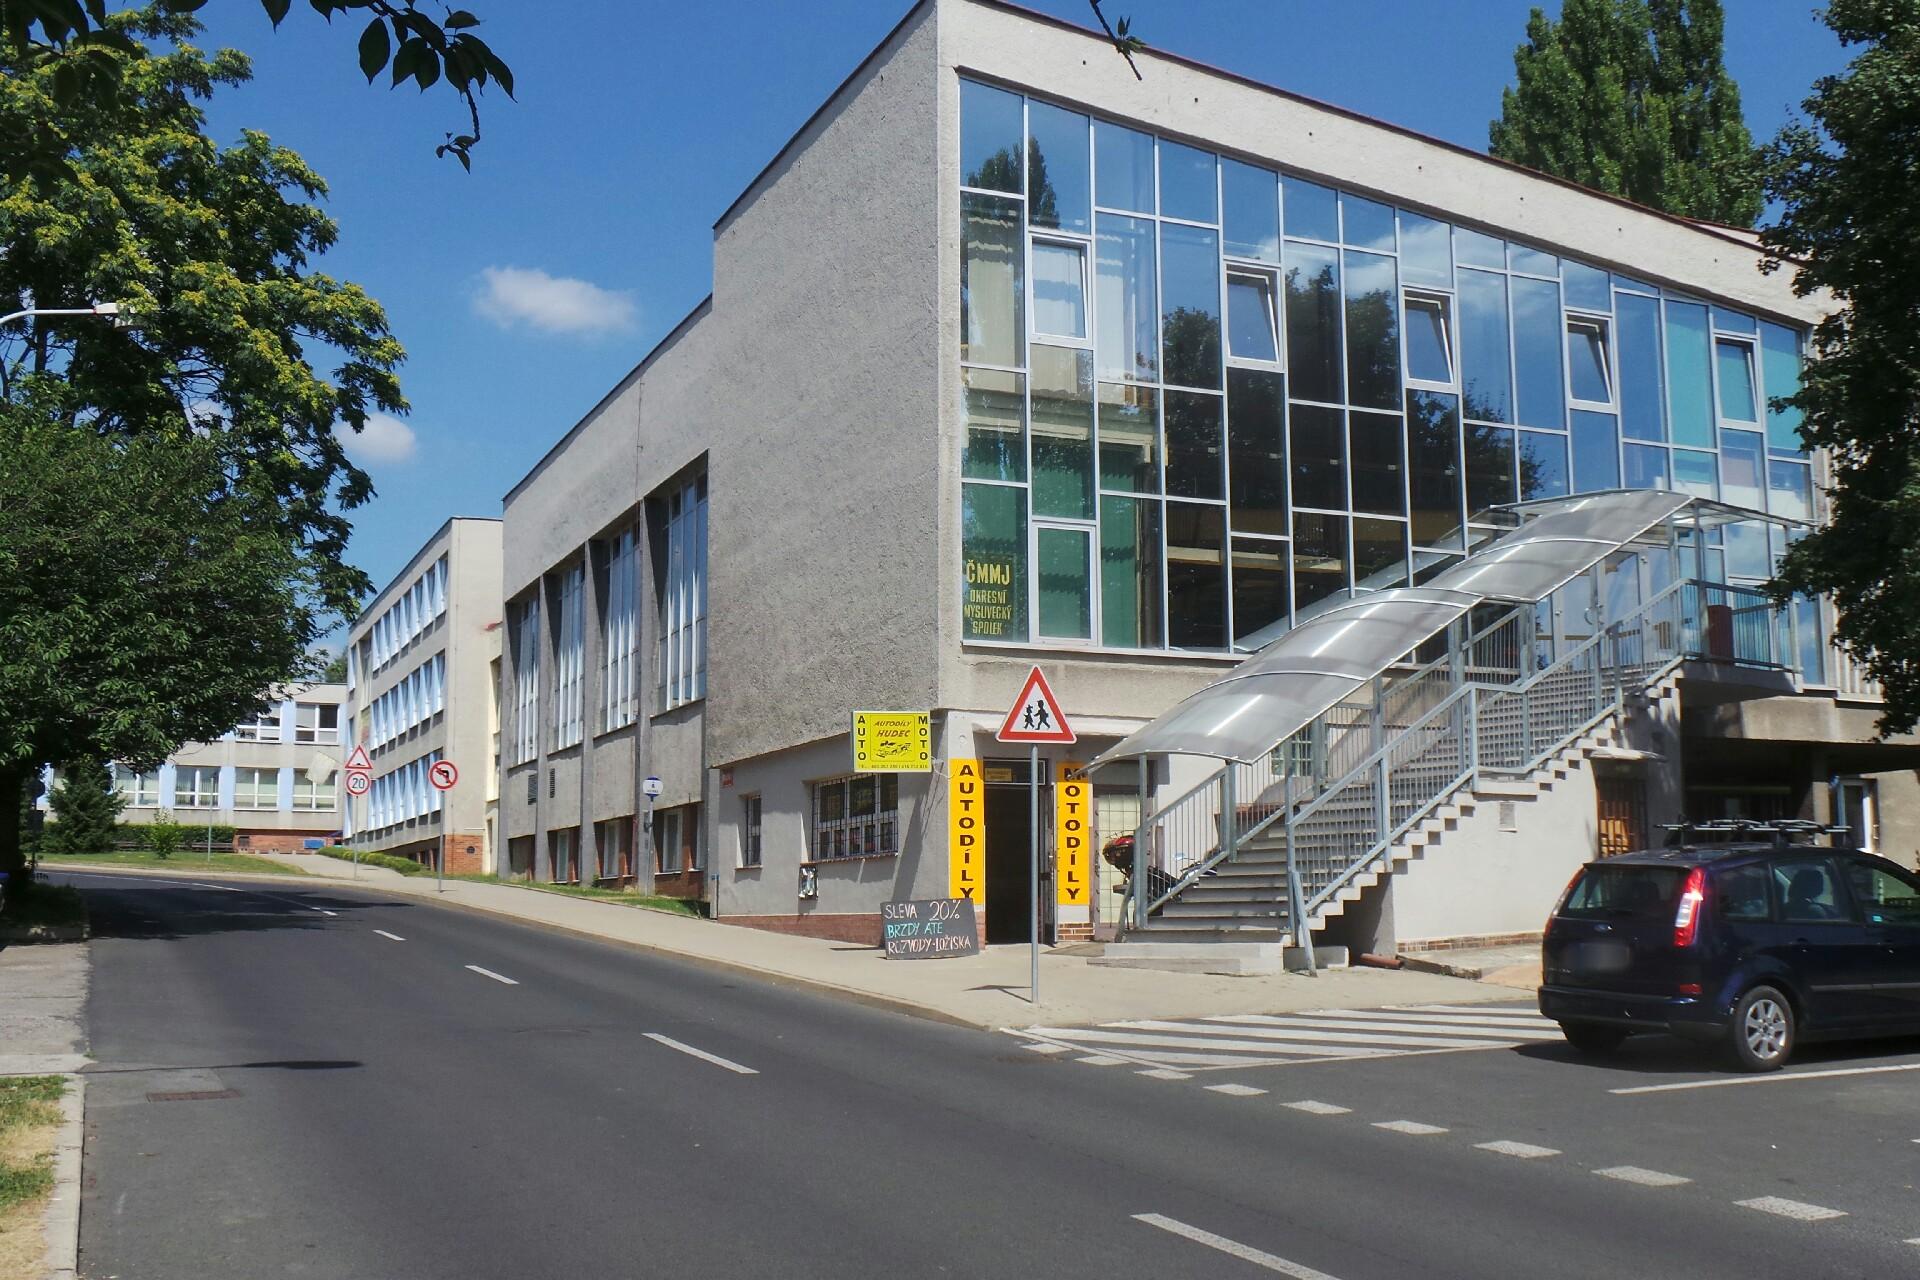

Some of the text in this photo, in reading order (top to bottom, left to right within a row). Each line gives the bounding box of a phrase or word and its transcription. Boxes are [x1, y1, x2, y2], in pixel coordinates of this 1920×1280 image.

[966, 559, 1010, 585] ČMMJ
[970, 589, 1007, 604] OKRESNÍ
[972, 621, 1003, 635] SPOLEK
[857, 715, 867, 761] AUTO
[876, 729, 911, 738] HUDEC
[918, 715, 928, 761] MOTO
[352, 778, 365, 789] 20
[959, 764, 975, 899] AUTODÍLY
[884, 899, 961, 922] SLEVA 20%
[887, 921, 944, 938] BRZDY ATE
